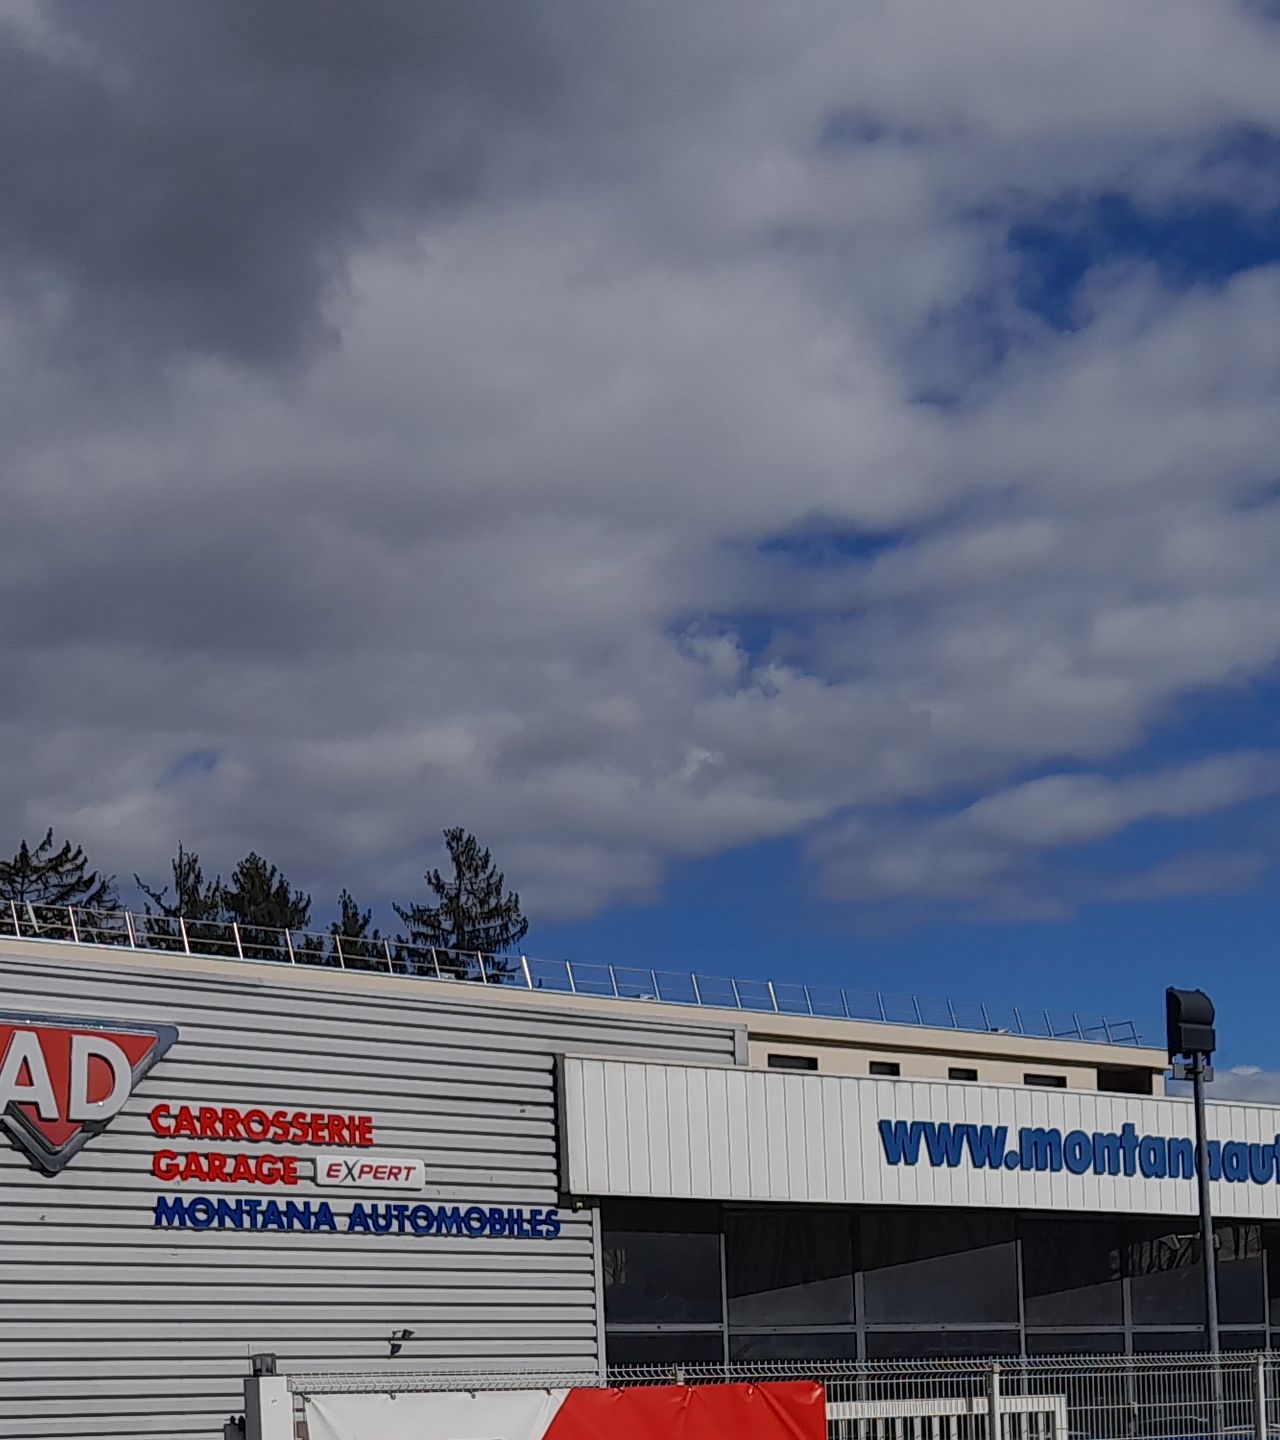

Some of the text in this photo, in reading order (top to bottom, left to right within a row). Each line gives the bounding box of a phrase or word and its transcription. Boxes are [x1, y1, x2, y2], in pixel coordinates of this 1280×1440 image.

[149, 1104, 374, 1146] CARROSSERIE
[152, 1149, 299, 1185] GARAGE
[326, 1159, 417, 1183] EXPERT
[154, 1195, 561, 1236] MONTANA AUTOMOBILES
